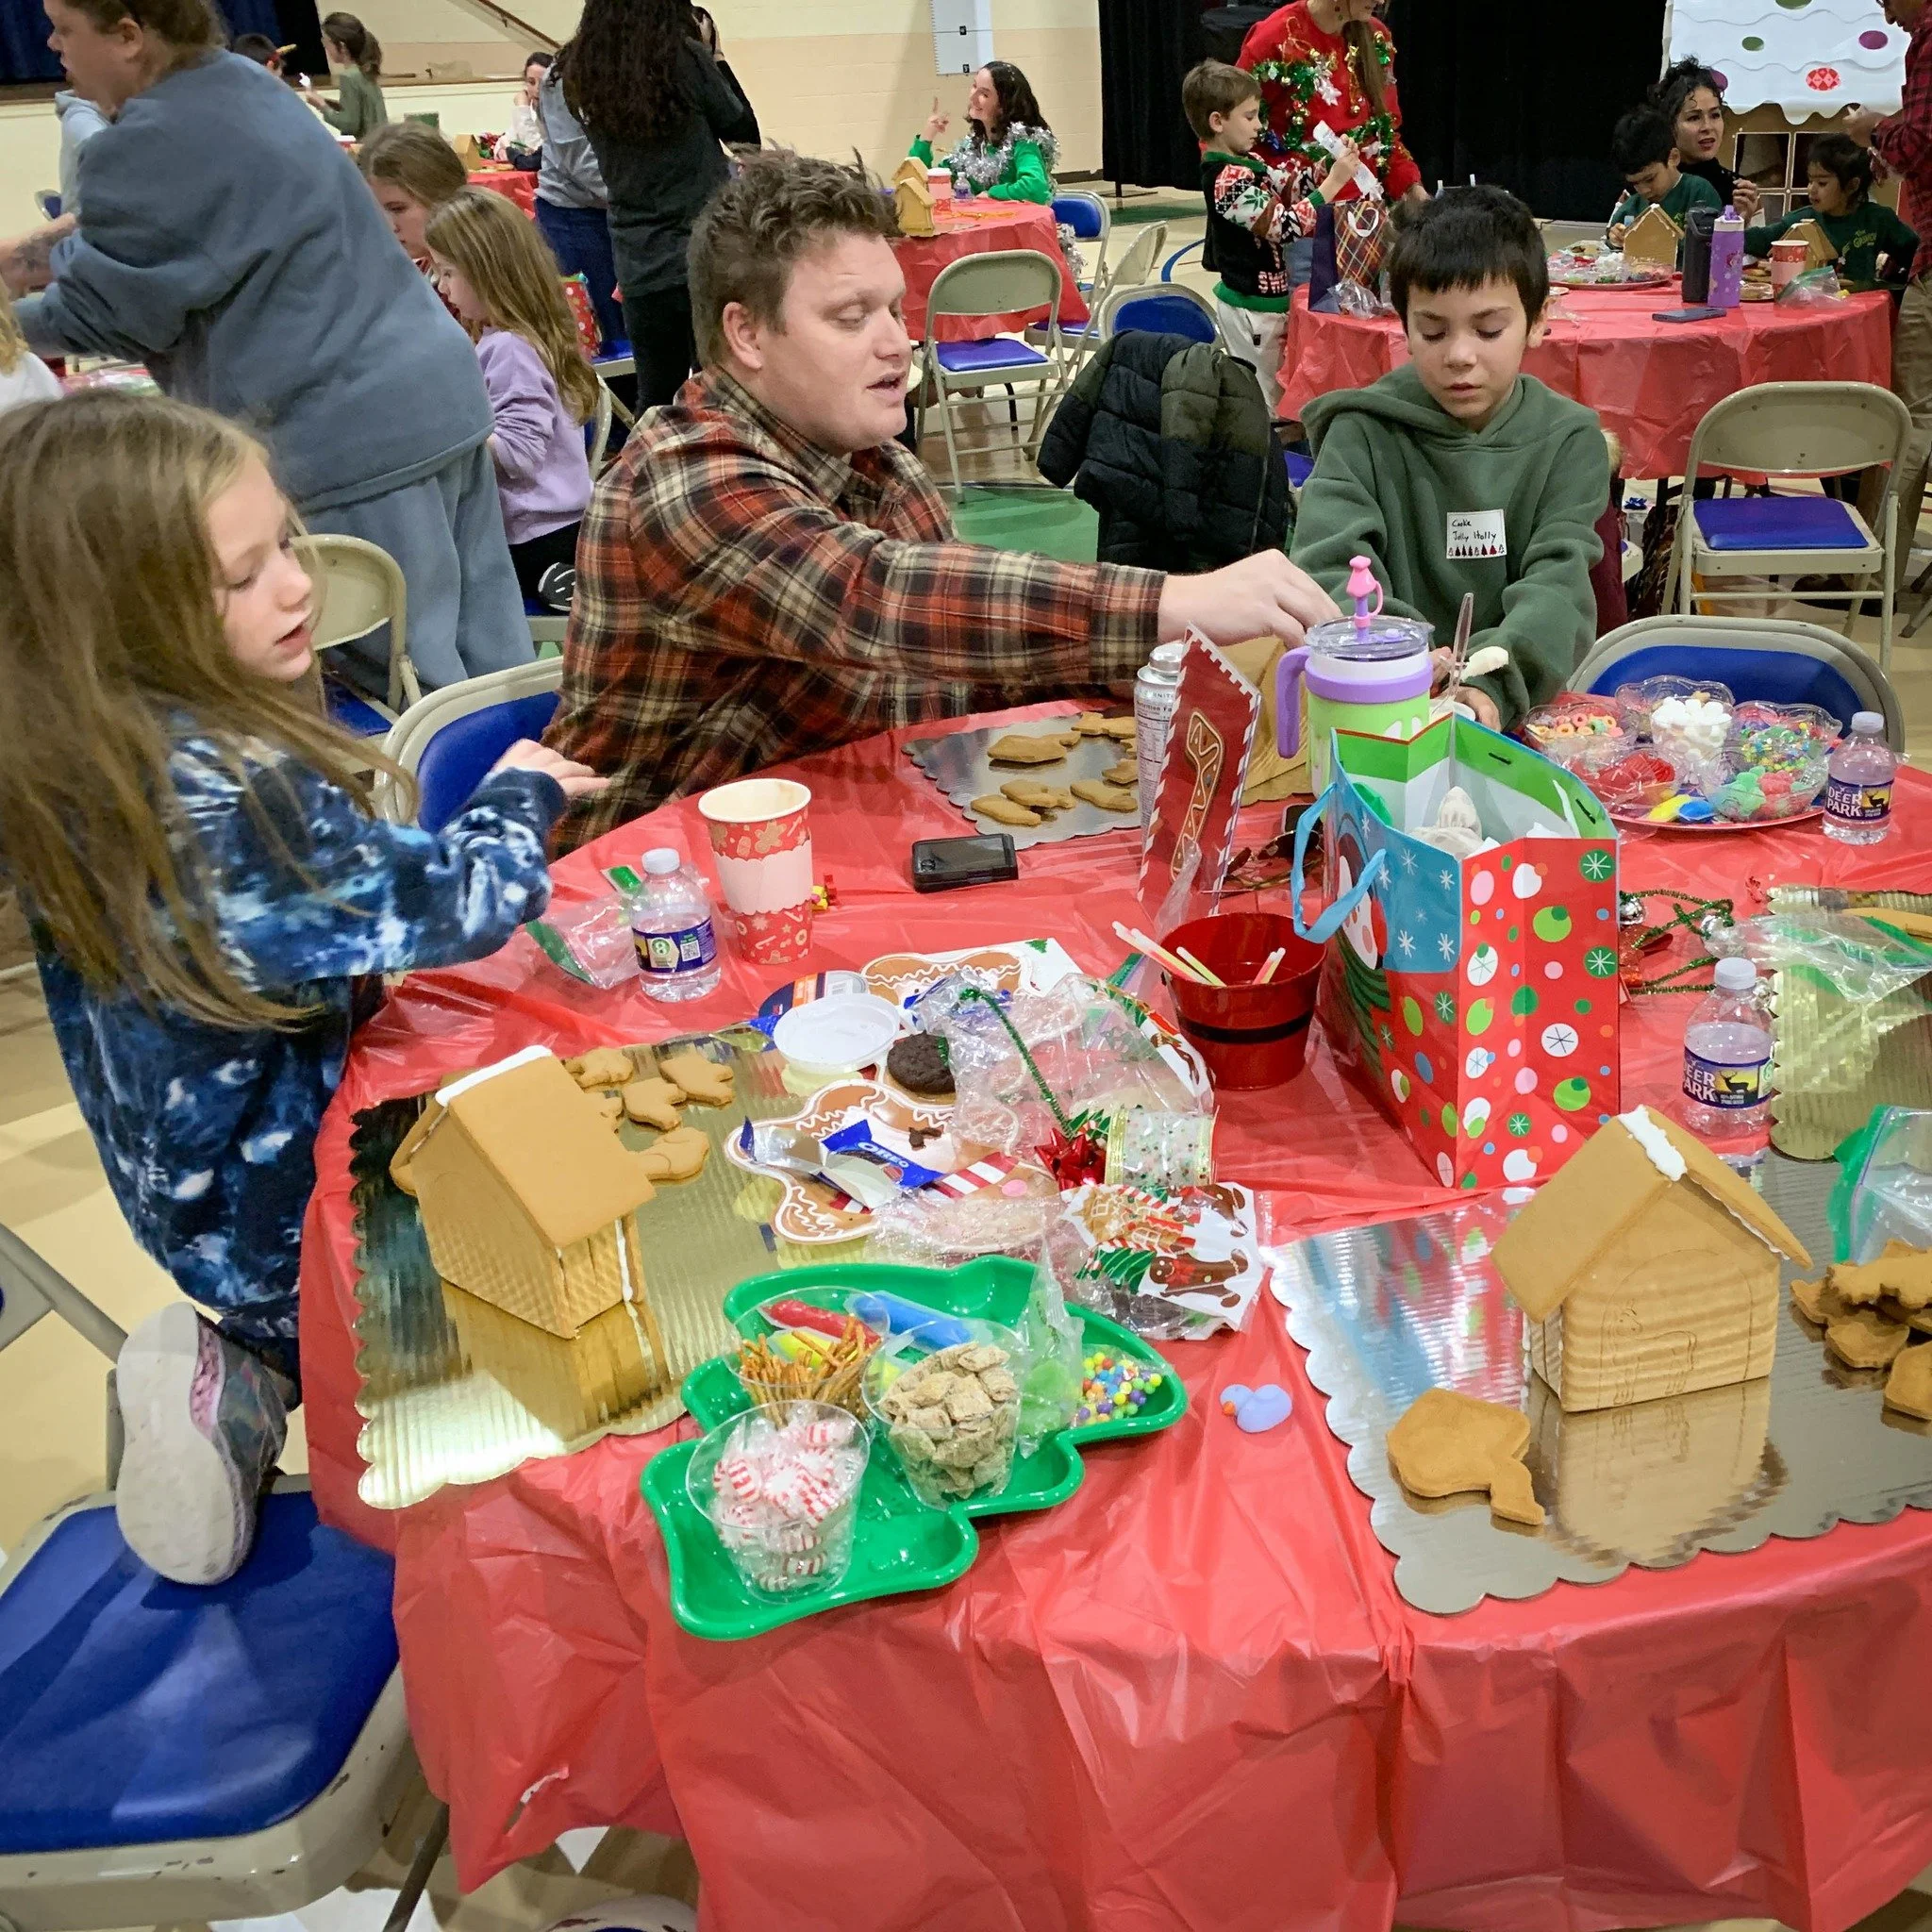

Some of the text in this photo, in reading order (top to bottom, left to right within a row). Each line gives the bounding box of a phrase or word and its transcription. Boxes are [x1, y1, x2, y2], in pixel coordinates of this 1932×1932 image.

[1473, 530, 1497, 544] Holly
[1826, 797, 1862, 818] PARK
[1828, 786, 1862, 806] DEER
[1684, 1062, 1716, 1088] EER
[1683, 1076, 1716, 1103] ARK
[858, 1141, 909, 1169] OREO
